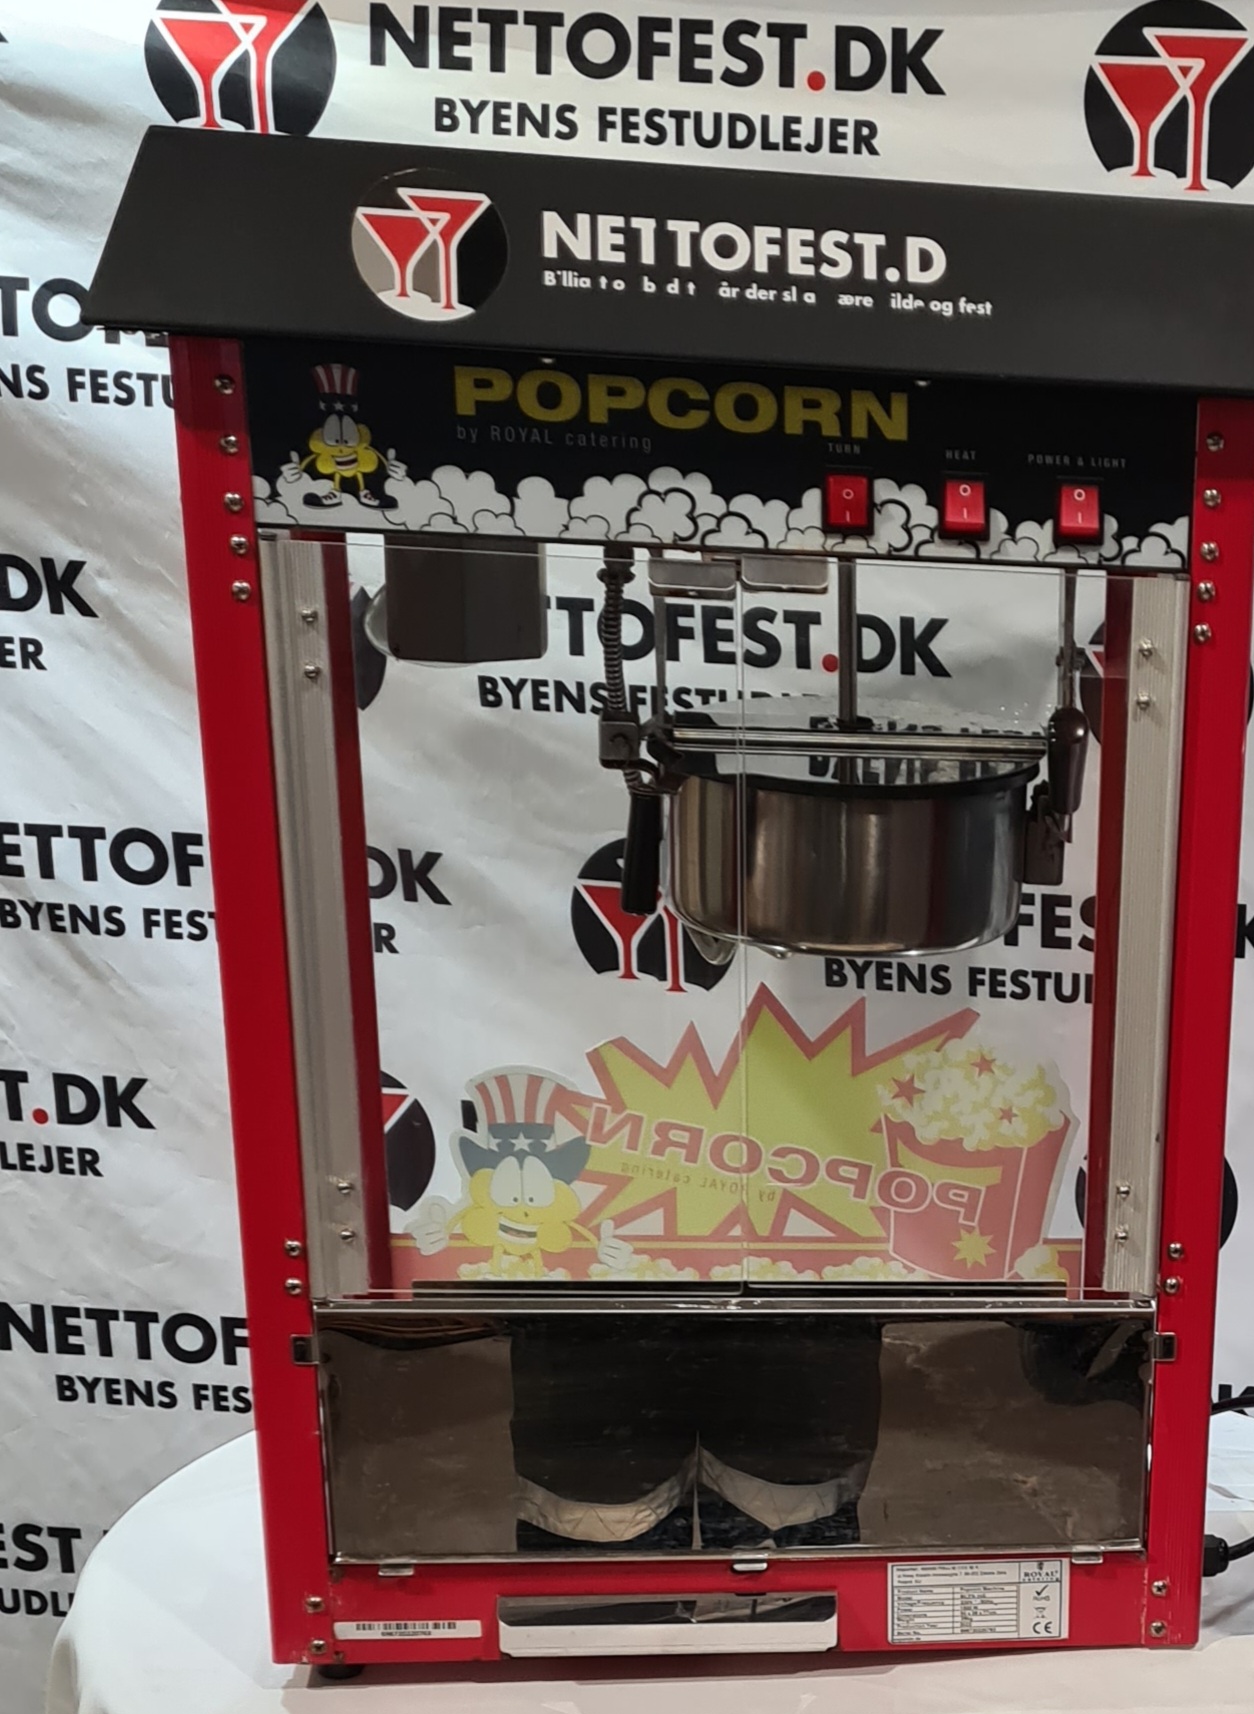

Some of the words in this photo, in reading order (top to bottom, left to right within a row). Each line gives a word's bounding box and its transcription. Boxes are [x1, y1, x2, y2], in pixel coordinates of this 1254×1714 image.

[369, 4, 946, 97] NETTOFEST.DK
[434, 98, 579, 141] BYENS
[598, 107, 881, 156] FESTUDLEJER
[929, 300, 955, 316] og
[958, 298, 994, 316] fest
[454, 365, 909, 441] POPCORN
[457, 425, 478, 443] by
[491, 426, 553, 446] ROYAL
[565, 430, 652, 453] catering
[827, 442, 861, 455] TURN
[946, 449, 977, 461] HEAT
[1028, 453, 1070, 466] POWER
[1091, 458, 1127, 469] LIGHT
[0, 899, 126, 938] BYENS
[824, 956, 952, 995] BYENS
[55, 1374, 178, 1410] BYENS
